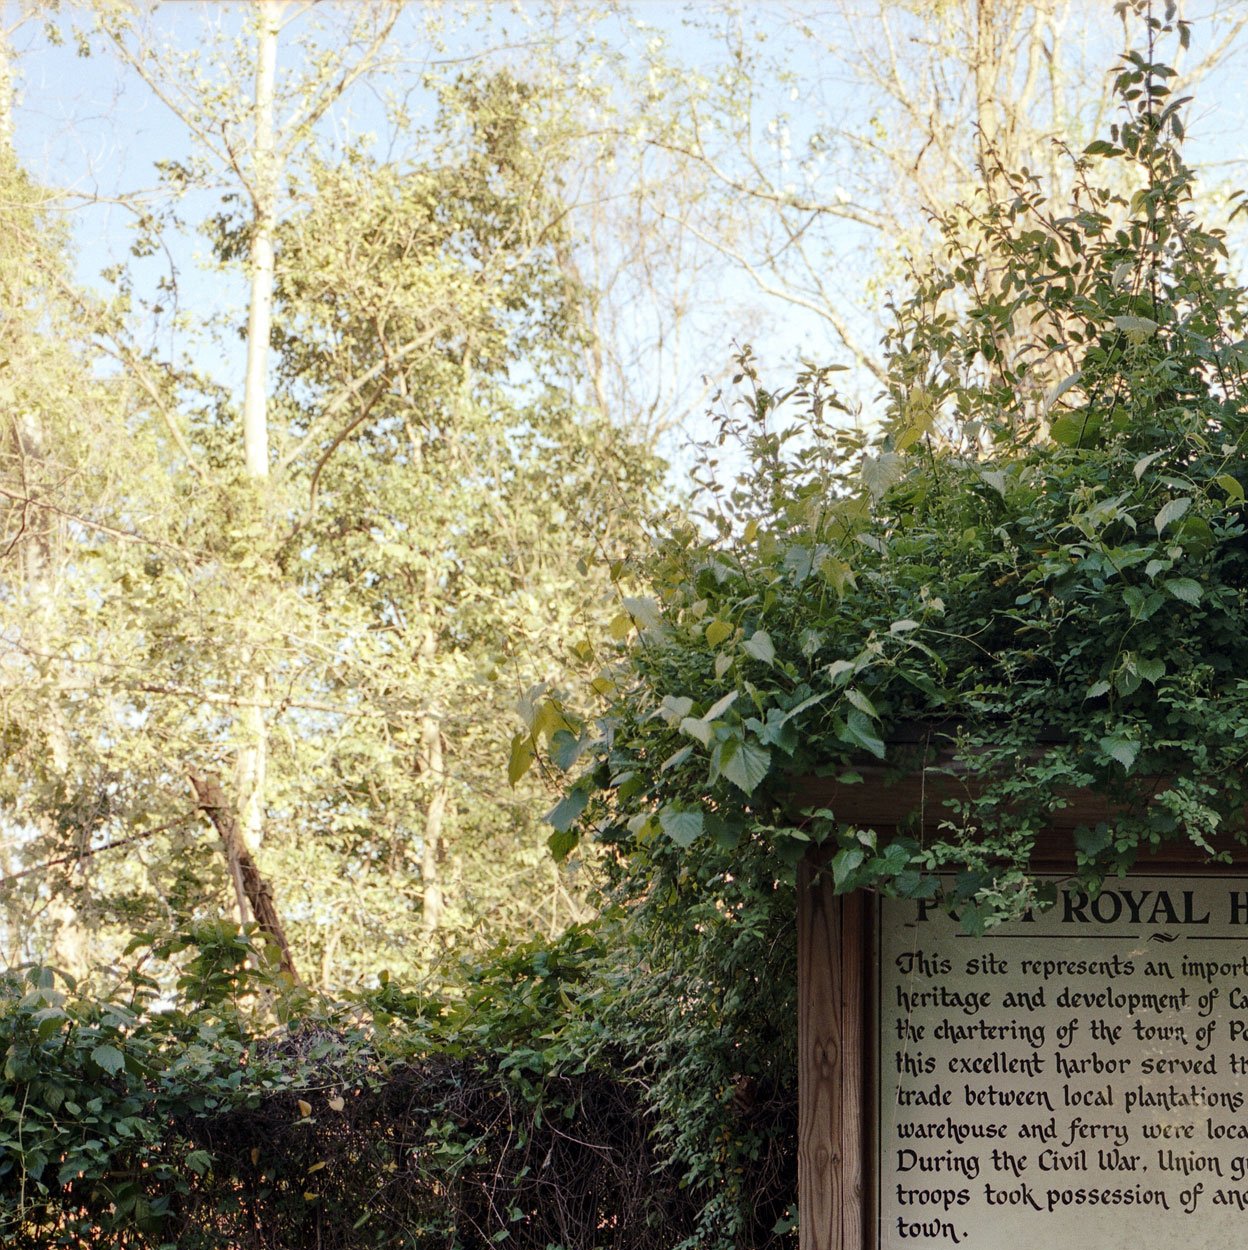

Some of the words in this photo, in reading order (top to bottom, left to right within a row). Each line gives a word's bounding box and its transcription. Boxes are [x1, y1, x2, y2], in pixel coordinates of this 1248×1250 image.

[1062, 890, 1210, 924] ROYAL
[894, 949, 953, 979] This
[965, 952, 1009, 976] site
[1020, 954, 1136, 981] represents
[1143, 961, 1175, 980] an
[895, 984, 992, 1016] heritage
[1002, 985, 1047, 1012] and
[1056, 986, 1191, 1016] development
[1197, 987, 1220, 1018] of
[894, 1017, 926, 1044] the
[933, 1018, 1046, 1049] chartering
[1056, 1017, 1080, 1049] of
[1088, 1018, 1123, 1046] the
[1132, 1018, 1189, 1046] town
[1195, 1019, 1217, 1052] of
[895, 1050, 937, 1078] this
[948, 1051, 1046, 1078] excellent
[1054, 1051, 1132, 1079] harbor
[1140, 1053, 1218, 1075] served
[895, 1083, 952, 1107] trade
[963, 1083, 1056, 1112] between
[1062, 1083, 1114, 1107] local
[1124, 1084, 1245, 1115] plantations
[896, 1116, 1008, 1145] warehouse
[1017, 1116, 1058, 1144] and
[1061, 1116, 1129, 1148] ferry
[1141, 1123, 1195, 1140] were
[895, 1148, 980, 1181] During
[989, 1148, 1028, 1178] the
[1038, 1148, 1088, 1172] Civil
[1097, 1148, 1148, 1173] War,
[1157, 1149, 1224, 1178] Union
[895, 1183, 971, 1212] troops
[983, 1182, 1044, 1212] took
[1046, 1183, 1171, 1213] possession
[1179, 1182, 1205, 1215] of
[895, 1216, 969, 1245] town.
